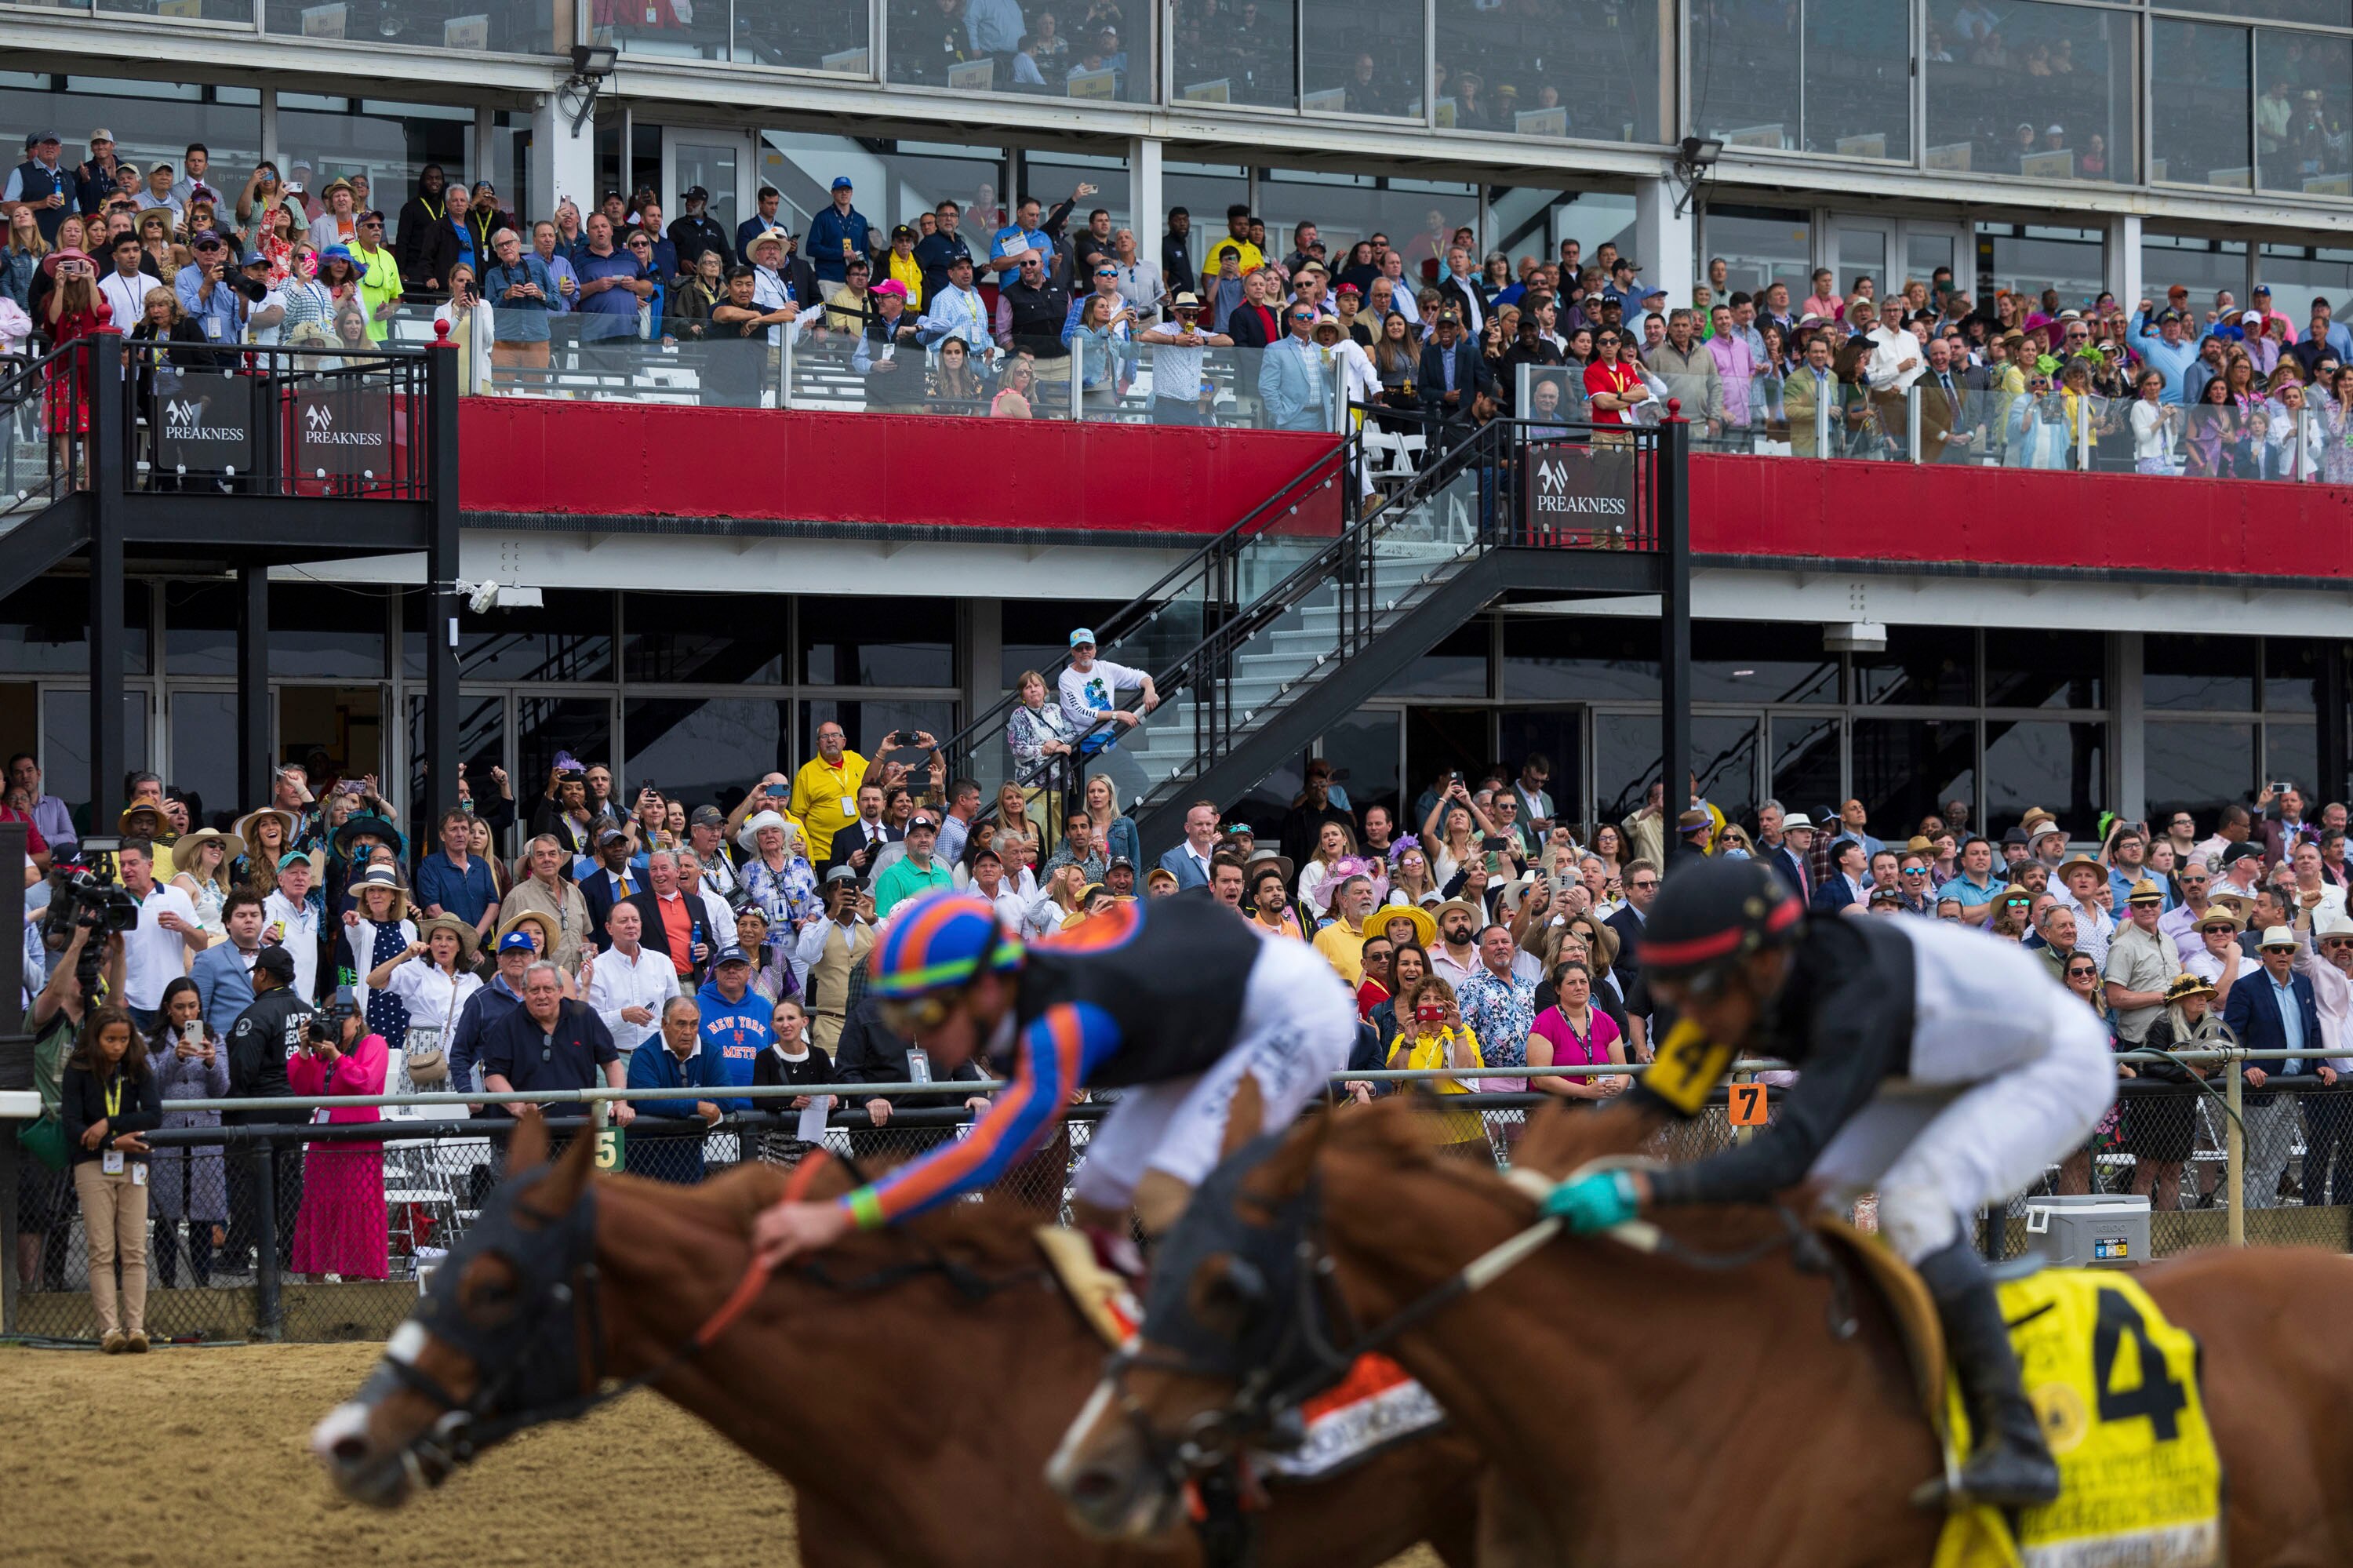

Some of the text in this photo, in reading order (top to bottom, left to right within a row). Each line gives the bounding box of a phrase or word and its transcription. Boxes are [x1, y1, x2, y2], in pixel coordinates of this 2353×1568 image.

[165, 426, 244, 441] PREAKNESS
[305, 431, 382, 446] PREAKNESS
[1537, 495, 1625, 515] PREAKNESS
[285, 1012, 313, 1028] APEX
[707, 1016, 766, 1037] NEW YORK
[723, 1046, 757, 1059] METS
[1739, 1089, 1758, 1120] 7
[595, 1132, 616, 1168] 5
[2097, 1224, 2127, 1232] IGLOO
[2094, 1286, 2188, 1442] 4
